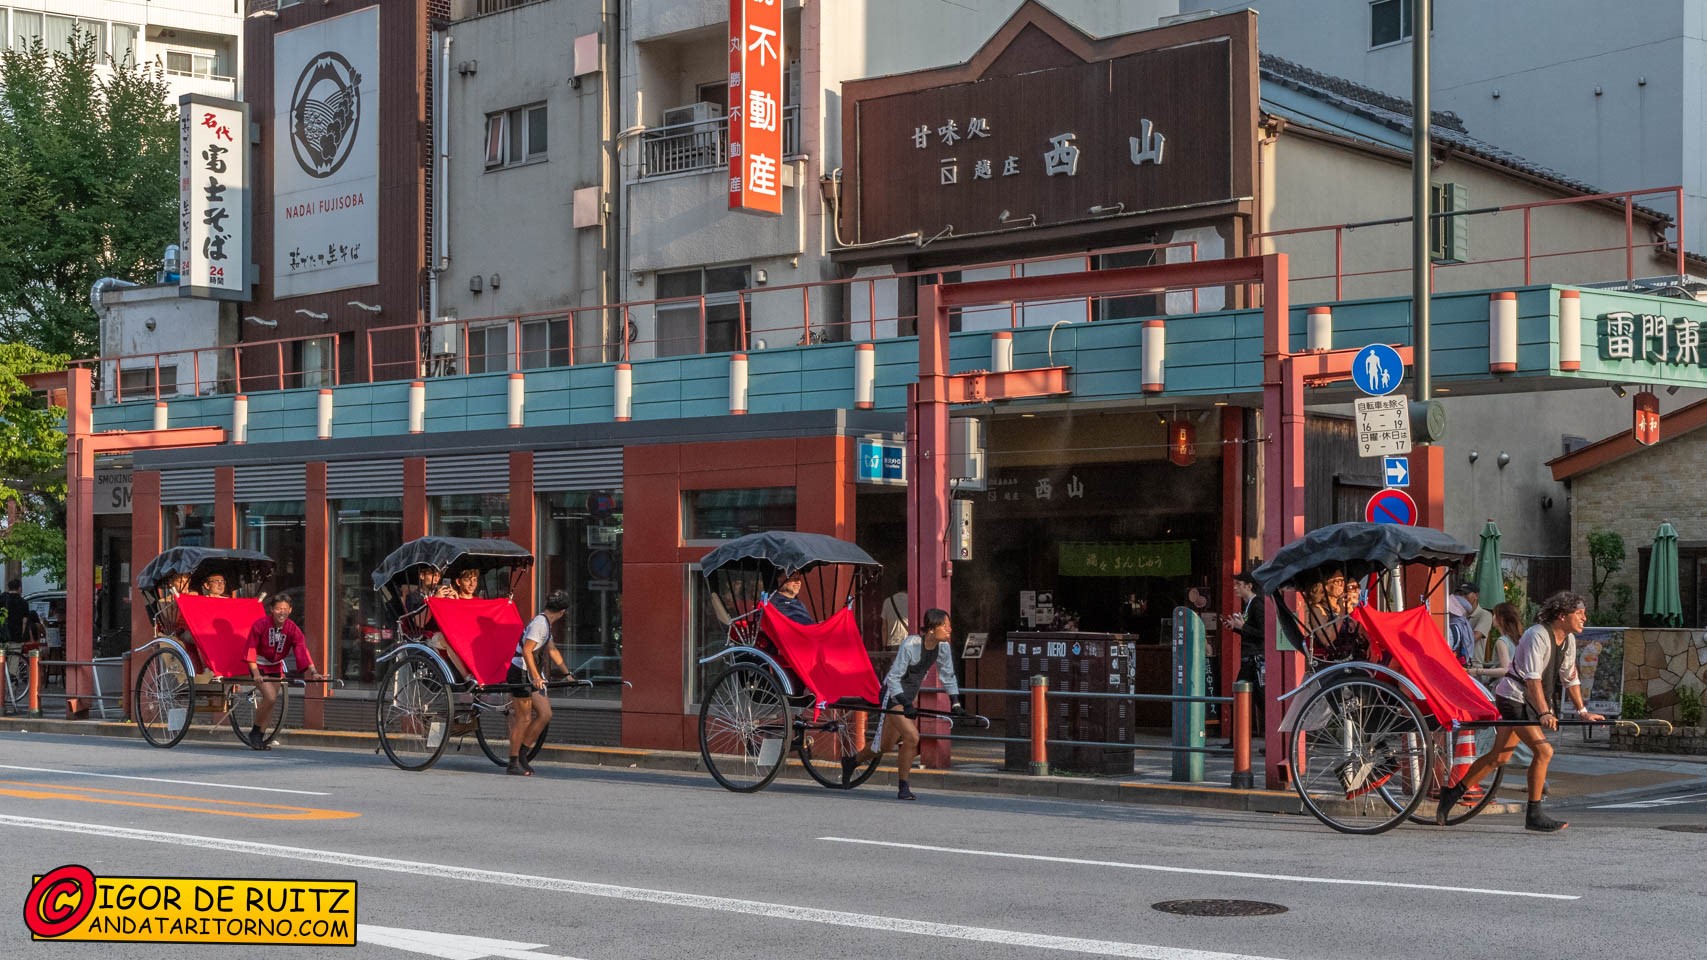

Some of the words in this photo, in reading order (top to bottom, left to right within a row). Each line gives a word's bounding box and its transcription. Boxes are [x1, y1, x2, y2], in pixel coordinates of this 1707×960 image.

[748, 0, 777, 197] 不動産
[729, 36, 741, 193] 丸勝不動産
[201, 112, 233, 142] 名代
[911, 117, 991, 149] 甘味処
[1044, 118, 1166, 176] 西山
[201, 144, 232, 261] 富士そば
[286, 202, 315, 219] NADAI
[319, 192, 364, 213] FUJISOBA
[182, 261, 190, 270] 24
[209, 266, 224, 276] 24
[209, 276, 225, 286] 時間
[1607, 311, 1700, 363] 雷門東
[1358, 400, 1404, 411] 自転車を除く
[1362, 413, 1368, 421] 7
[1396, 410, 1402, 418] 9
[1362, 423, 1372, 432] 16
[1394, 420, 1403, 429] 19
[1360, 431, 1408, 442] 日曜・休日は
[1364, 444, 1370, 452] 9
[1396, 441, 1405, 450] 17
[98, 474, 133, 484] SMOKING
[1035, 475, 1084, 500] 西山
[1047, 642, 1067, 657] NERO
